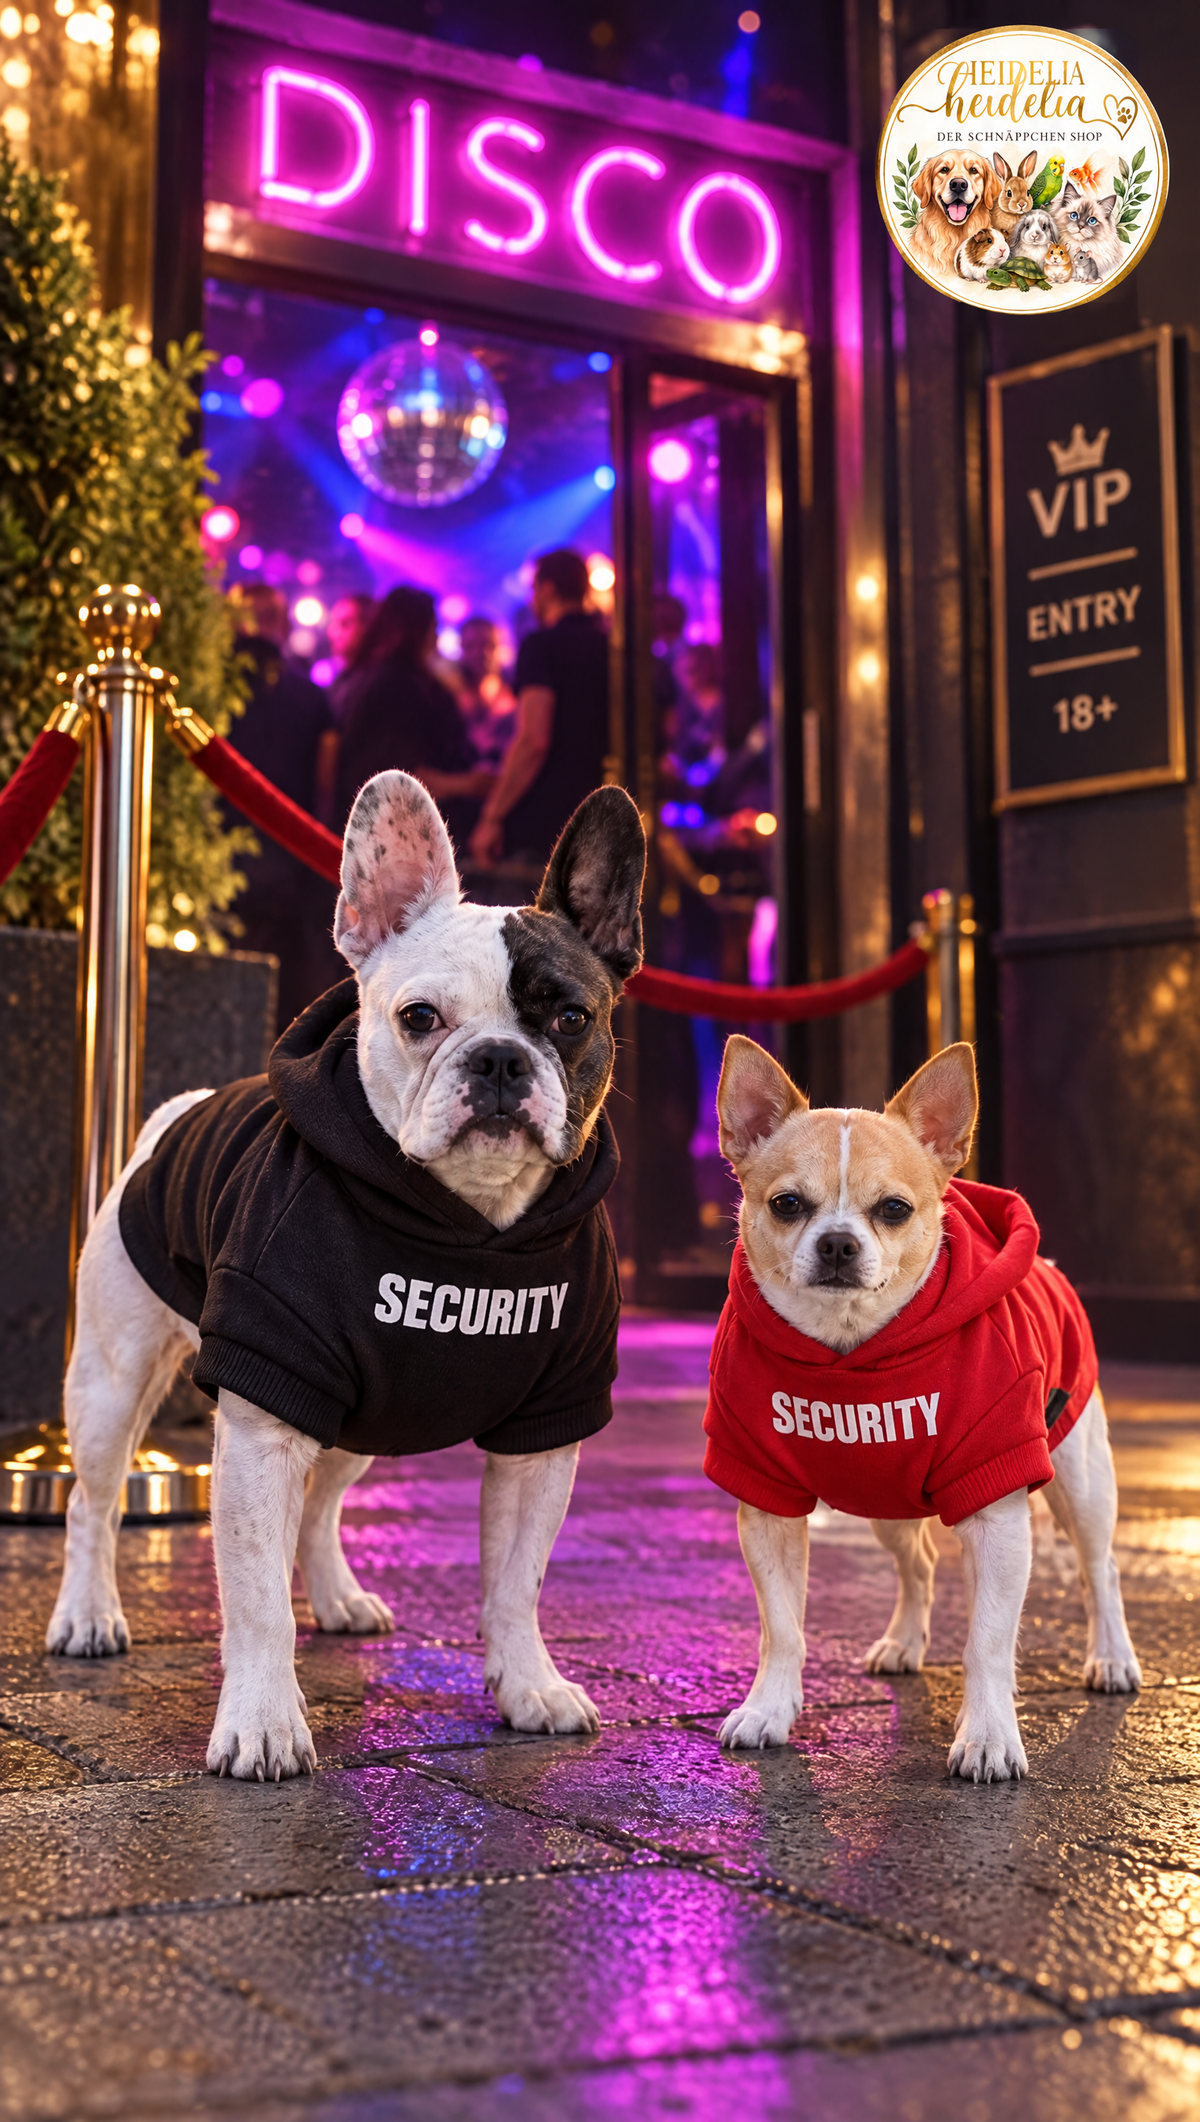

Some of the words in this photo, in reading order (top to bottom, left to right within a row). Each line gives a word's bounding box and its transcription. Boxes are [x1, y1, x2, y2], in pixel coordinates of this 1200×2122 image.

[260, 65, 782, 304] DISCO
[1027, 468, 1132, 538] VIP
[1027, 584, 1142, 642] ENTRY
[1053, 694, 1118, 733] 18+
[374, 1272, 569, 1335] SECURITY
[771, 1391, 940, 1444] SECURITY
